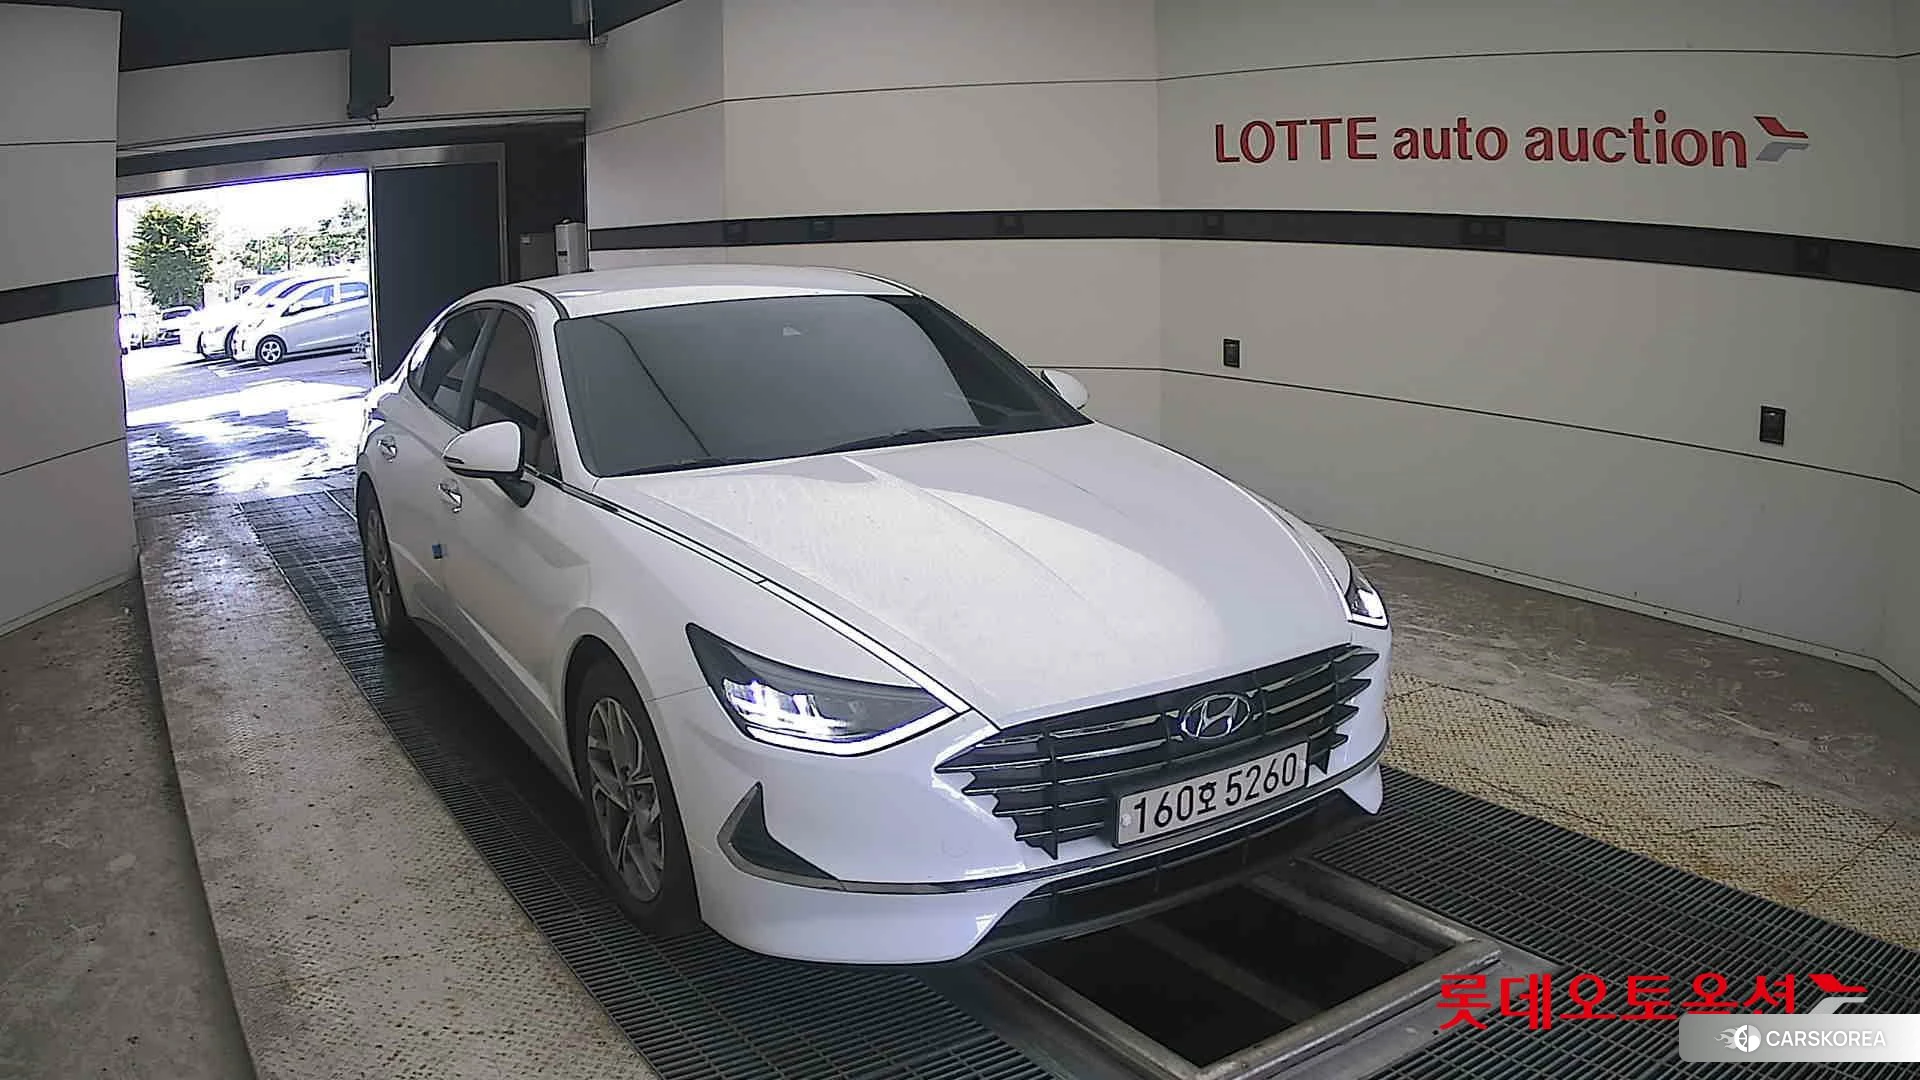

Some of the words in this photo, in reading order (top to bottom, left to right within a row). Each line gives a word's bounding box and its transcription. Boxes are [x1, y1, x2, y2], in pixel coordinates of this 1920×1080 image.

[1214, 116, 1378, 163] LOTTE
[1393, 116, 1509, 162] auto
[1524, 109, 1748, 169] auction
[1133, 780, 1217, 833] 160호
[1225, 752, 1297, 807] 5260
